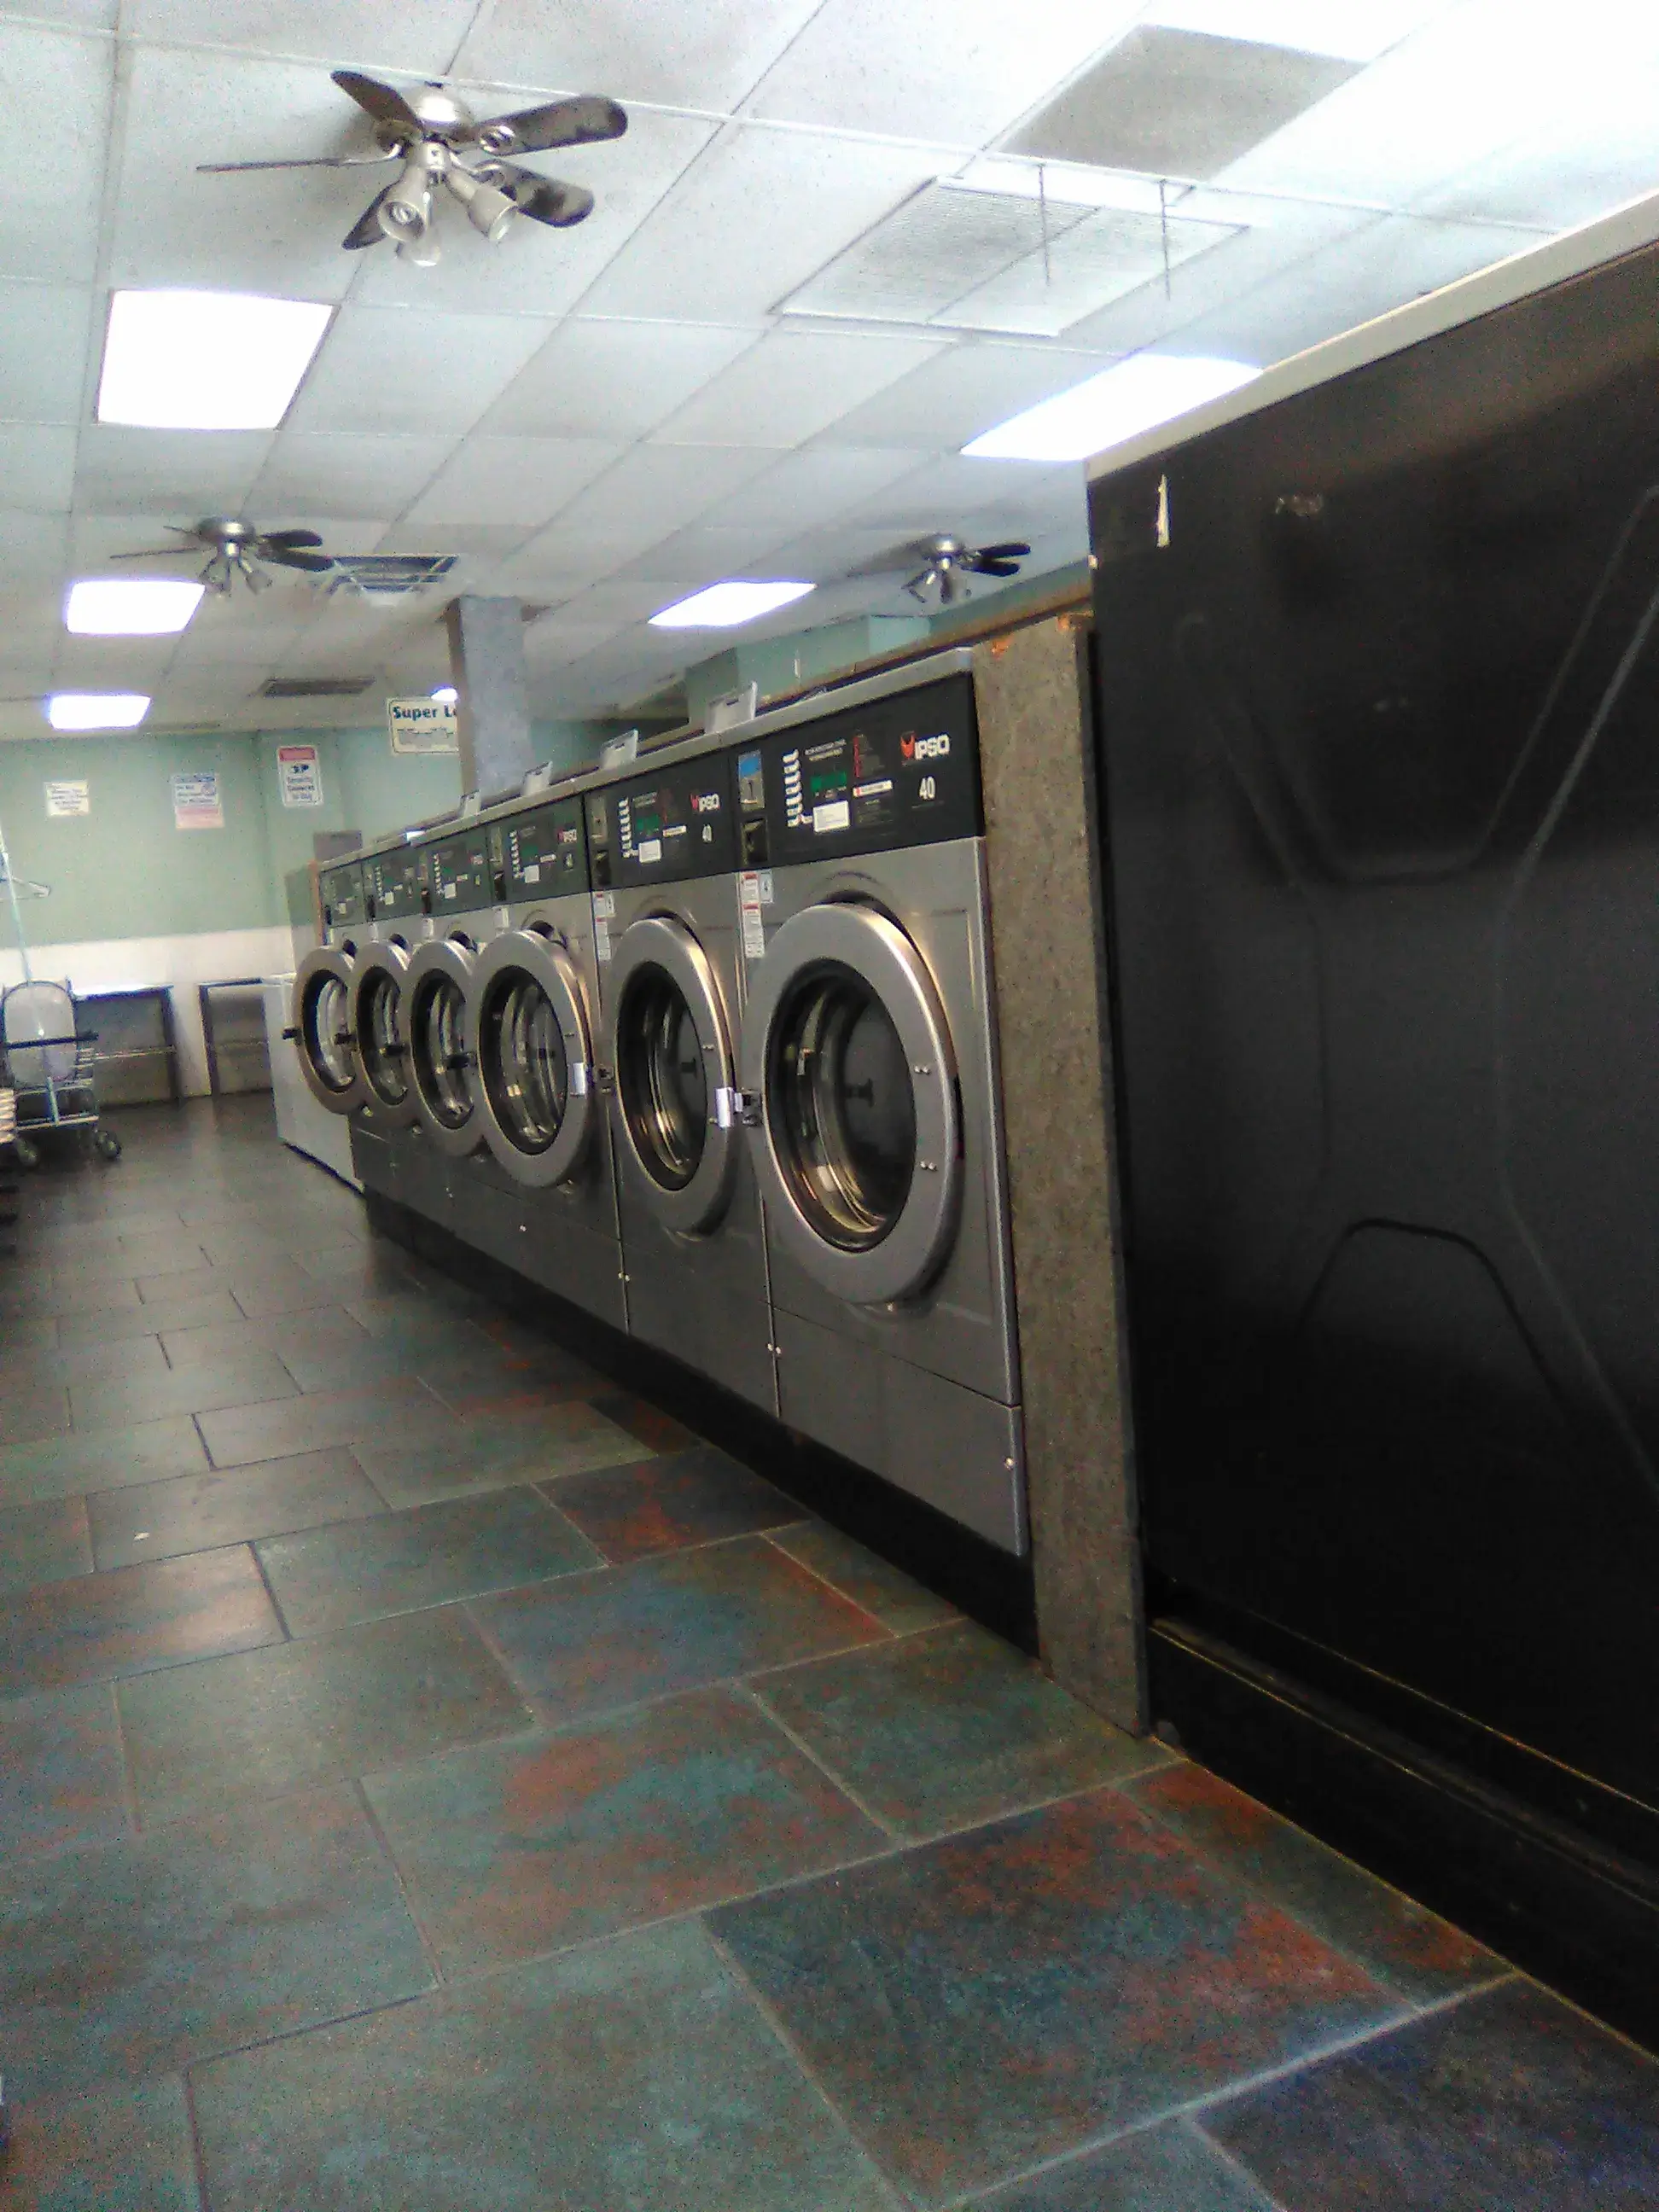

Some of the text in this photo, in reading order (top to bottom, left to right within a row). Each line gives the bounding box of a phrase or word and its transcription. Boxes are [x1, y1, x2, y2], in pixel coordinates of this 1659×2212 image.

[393, 706, 436, 721] Super
[914, 734, 949, 760] IPSO
[919, 776, 935, 800] 40
